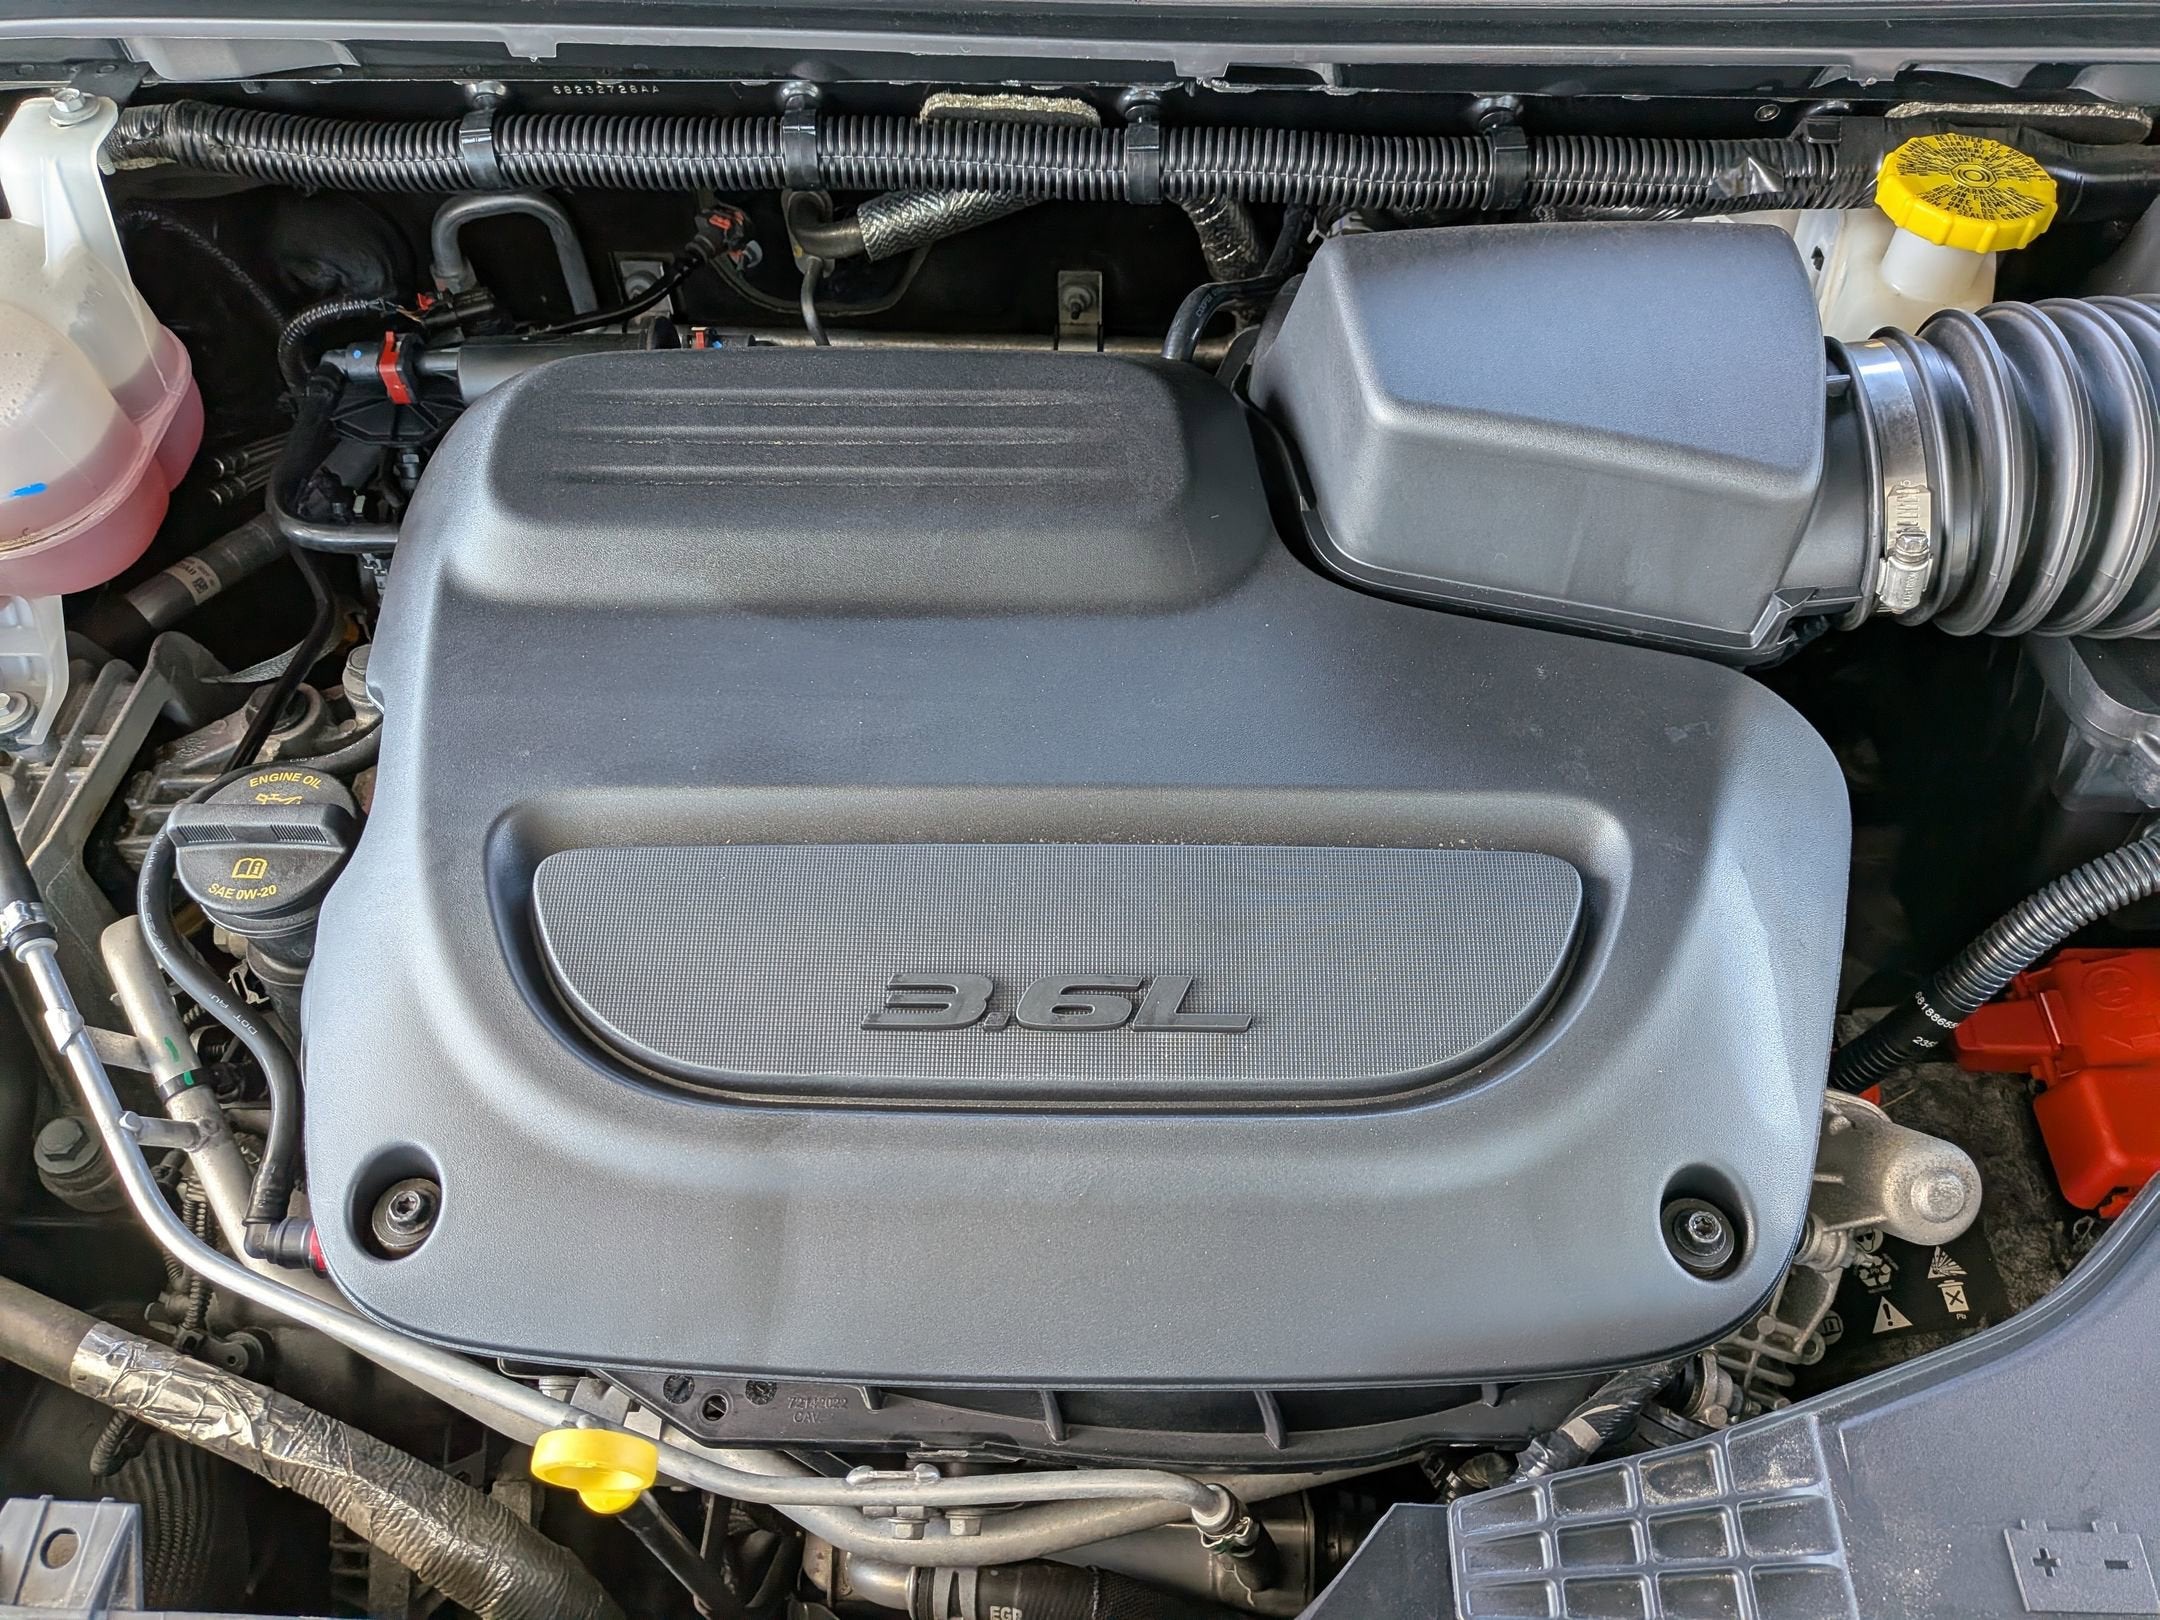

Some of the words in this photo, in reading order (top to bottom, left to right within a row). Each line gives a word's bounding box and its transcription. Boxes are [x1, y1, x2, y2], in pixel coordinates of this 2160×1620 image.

[1931, 186, 1970, 205] BEFORE
[1940, 183, 1967, 198] CLEAN
[1956, 184, 2001, 195] WARNING
[1946, 200, 1973, 211] ONLY
[1957, 208, 1996, 219] SEALED
[249, 772, 302, 788] ENGINE
[303, 775, 323, 789] OIL
[208, 883, 234, 900] SAE
[235, 884, 277, 900] 0W-20
[861, 972, 1253, 1033] 3.6L
